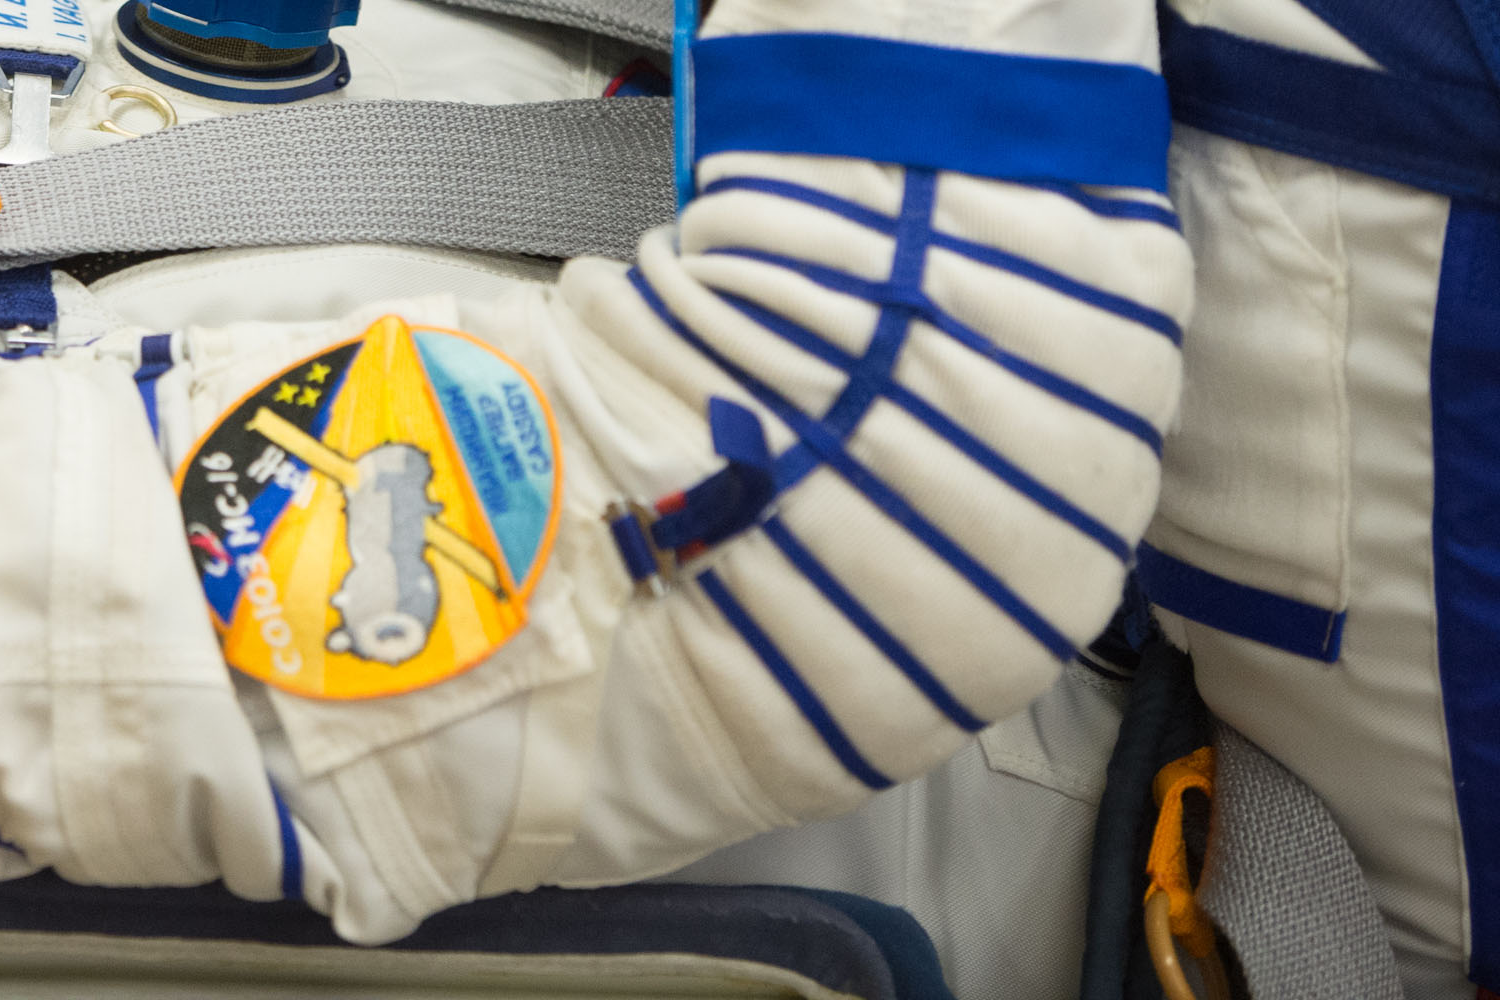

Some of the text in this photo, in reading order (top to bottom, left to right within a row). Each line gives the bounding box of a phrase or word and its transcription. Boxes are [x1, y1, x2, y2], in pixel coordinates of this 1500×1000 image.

[55, 31, 88, 43] I.
[201, 450, 303, 676] СОЮЗ МС-16
